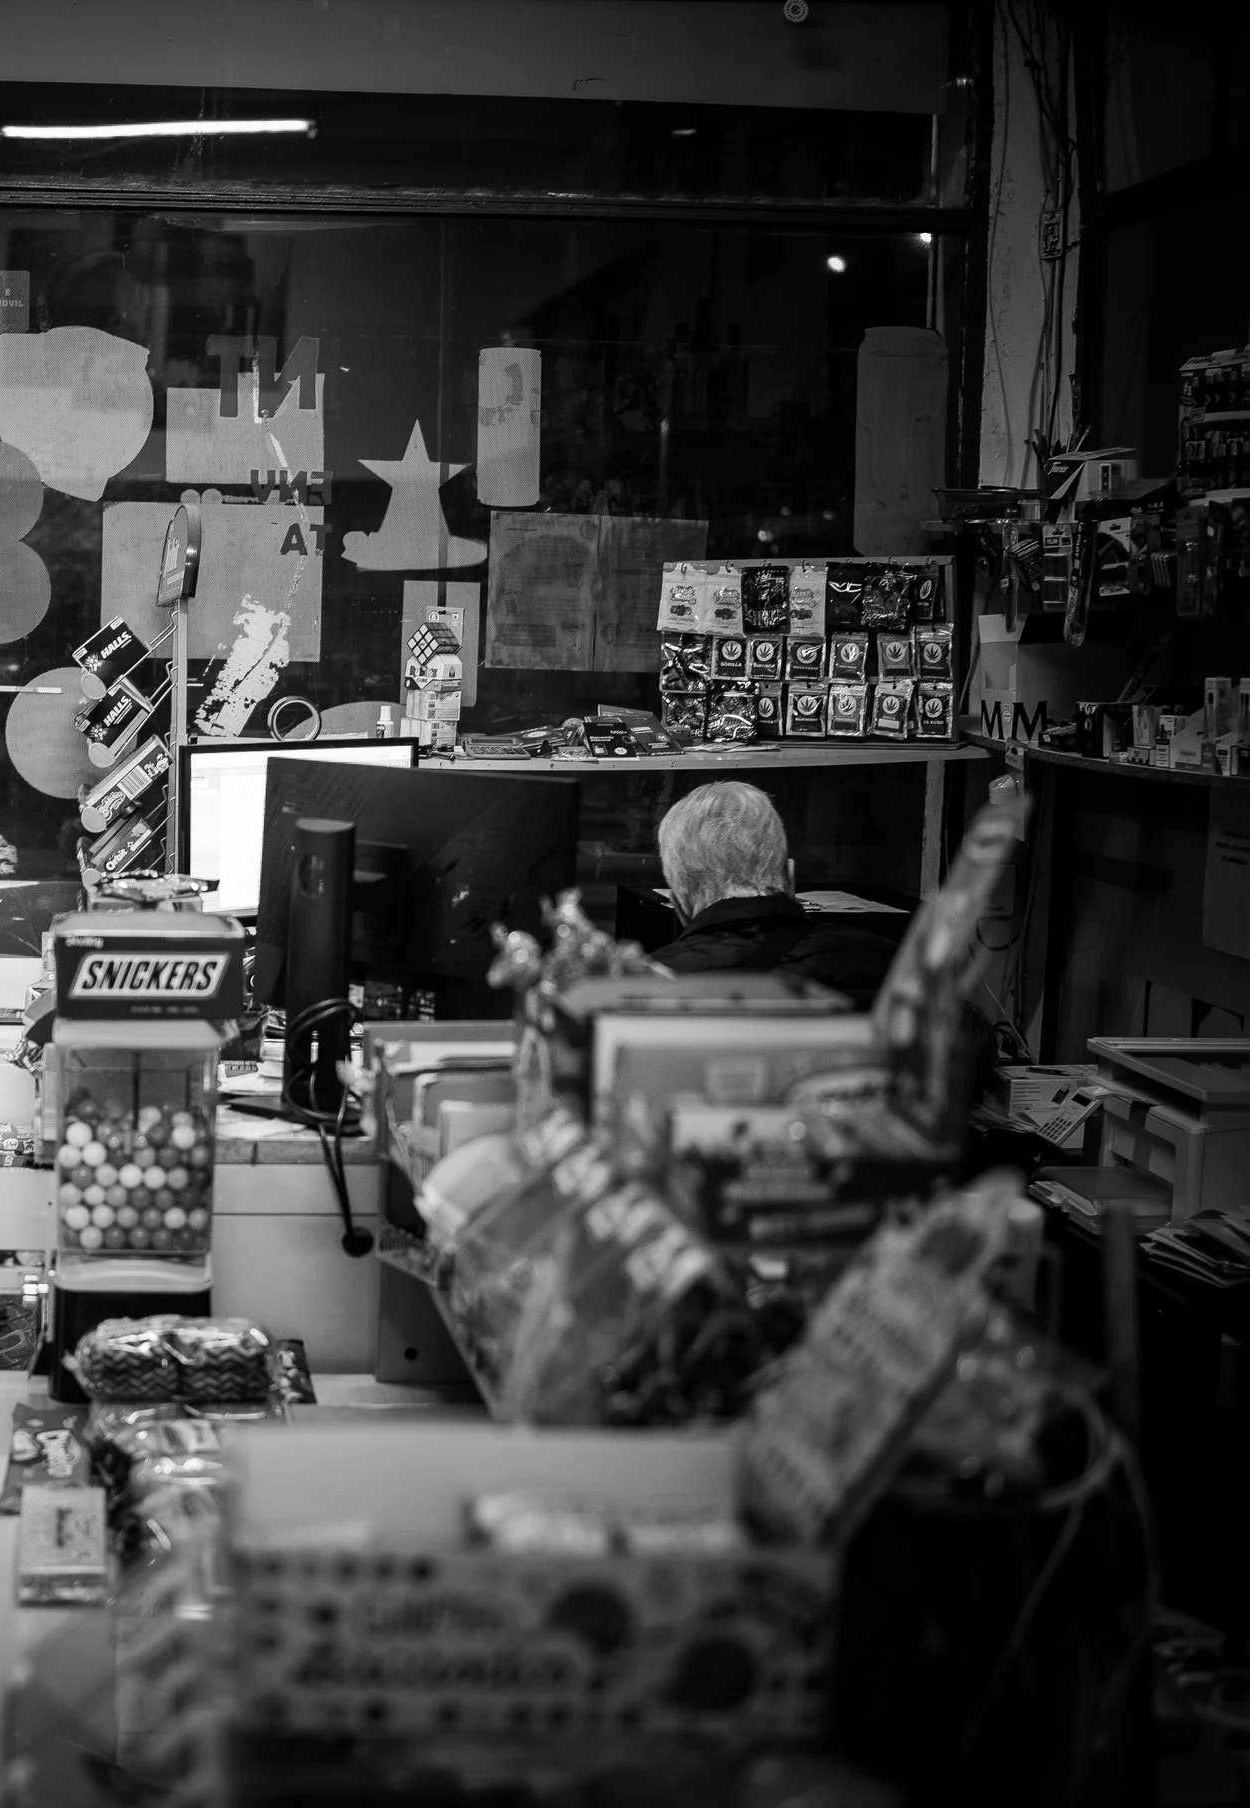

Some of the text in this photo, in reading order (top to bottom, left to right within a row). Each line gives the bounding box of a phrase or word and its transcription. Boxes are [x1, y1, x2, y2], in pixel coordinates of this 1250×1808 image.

[101, 631, 132, 659] HALLS
[103, 695, 132, 727] HALLS
[105, 849, 128, 871] Orbit
[82, 960, 217, 990] SNICKERS
